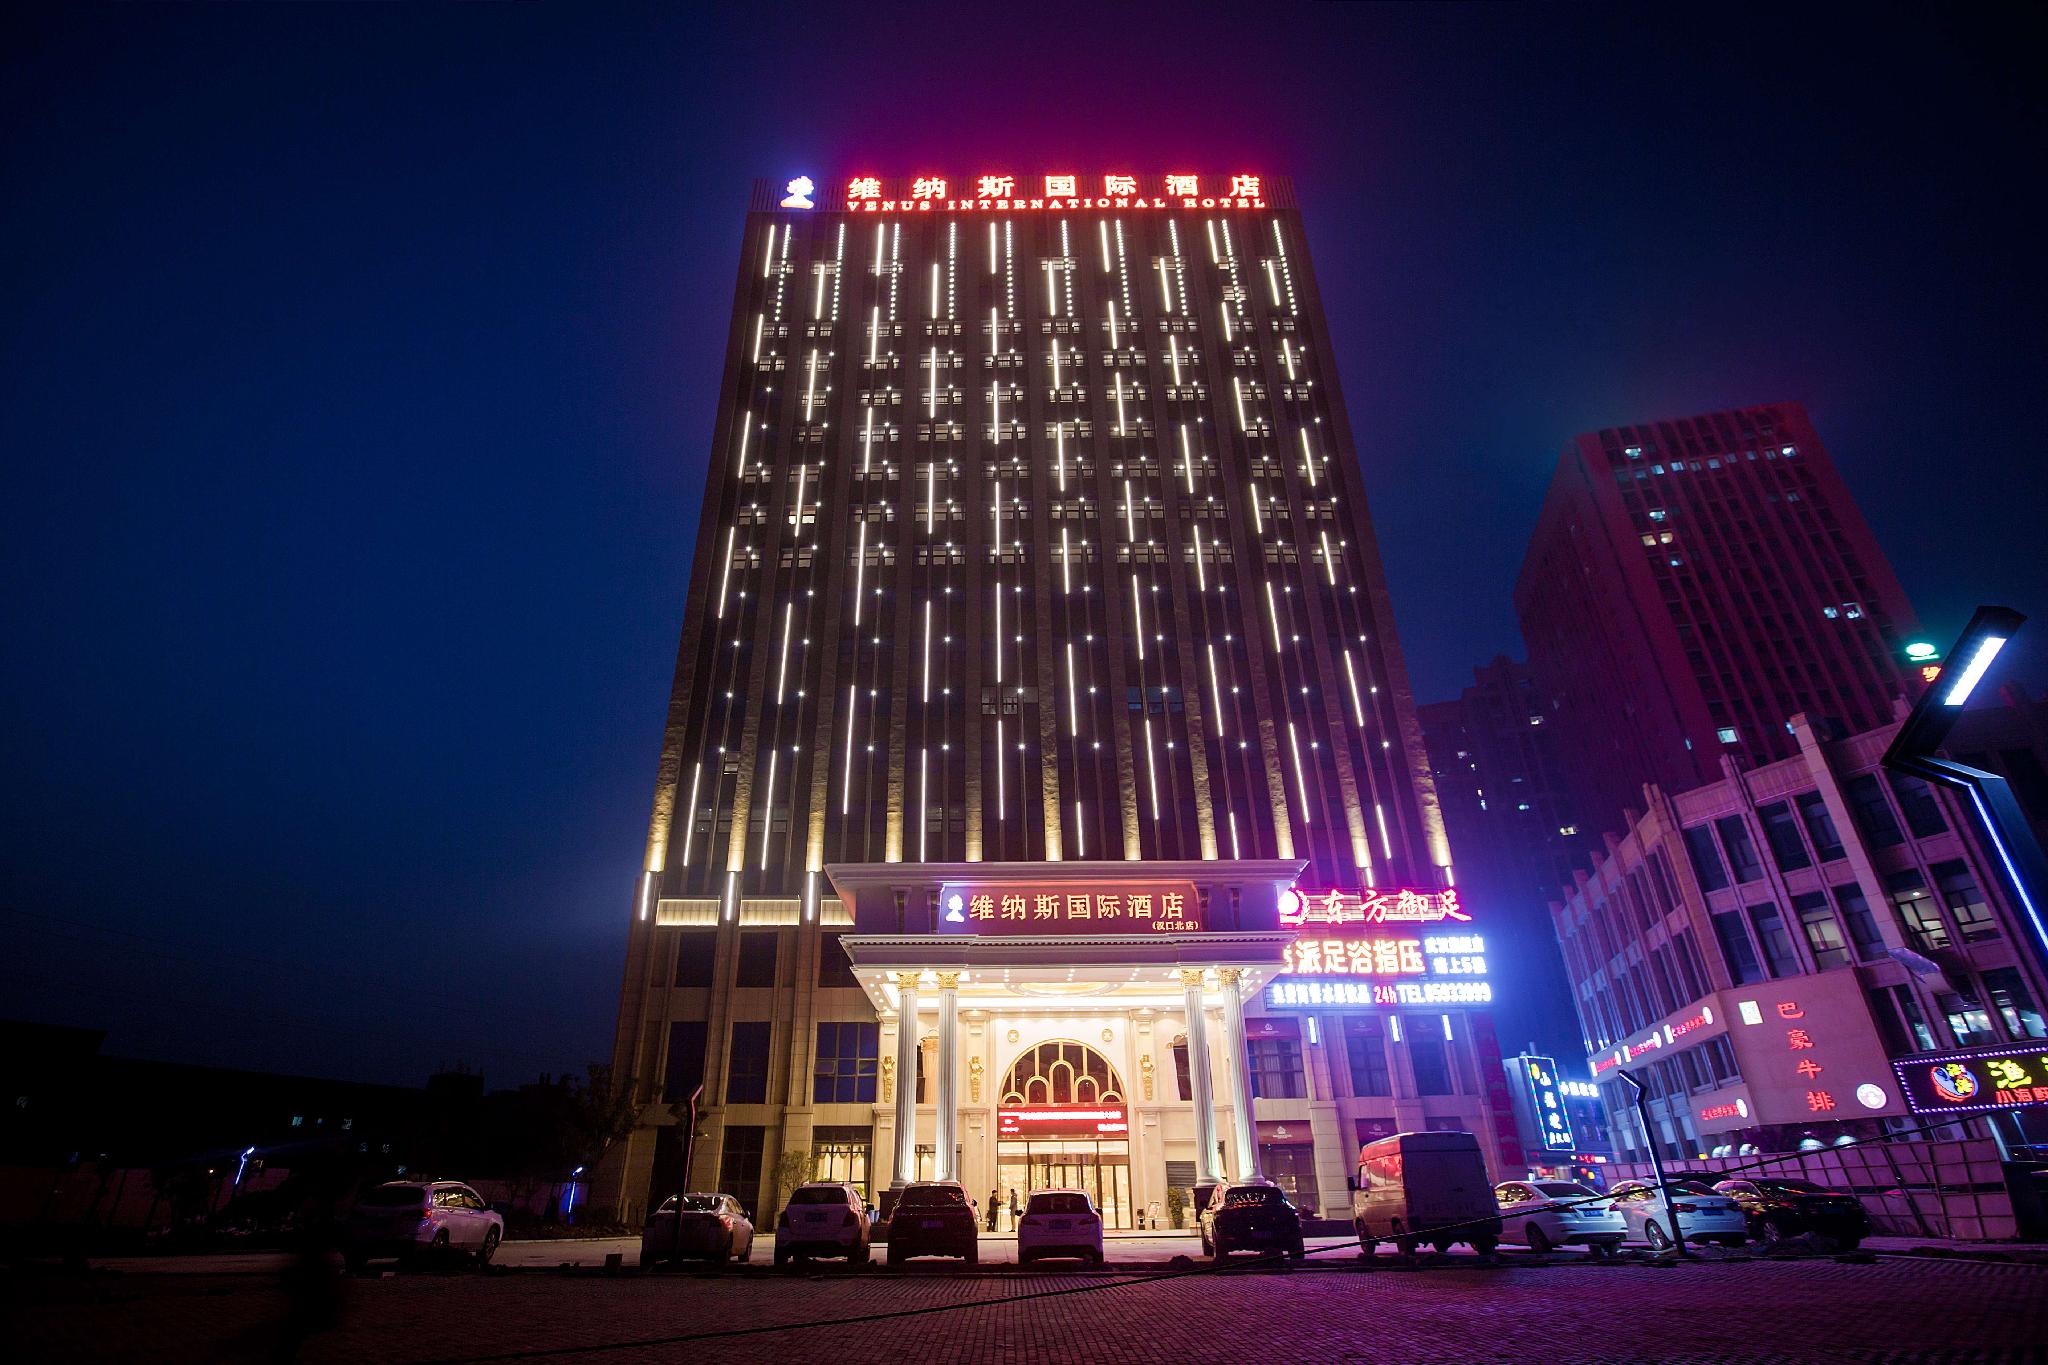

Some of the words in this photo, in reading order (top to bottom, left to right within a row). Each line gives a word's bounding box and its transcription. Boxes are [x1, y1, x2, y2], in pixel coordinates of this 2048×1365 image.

[848, 175, 1260, 199] 维纳斯国际酒店
[847, 200, 931, 211] VENUS
[948, 199, 1166, 210] INTERNATIONAL
[1184, 198, 1266, 208] HOTEL
[969, 892, 1185, 920] 维纳斯国际酒店
[1322, 889, 1473, 924] 东方御足
[1373, 985, 1398, 1004] 24h
[1777, 1002, 1836, 1112] 巴豪牛排
